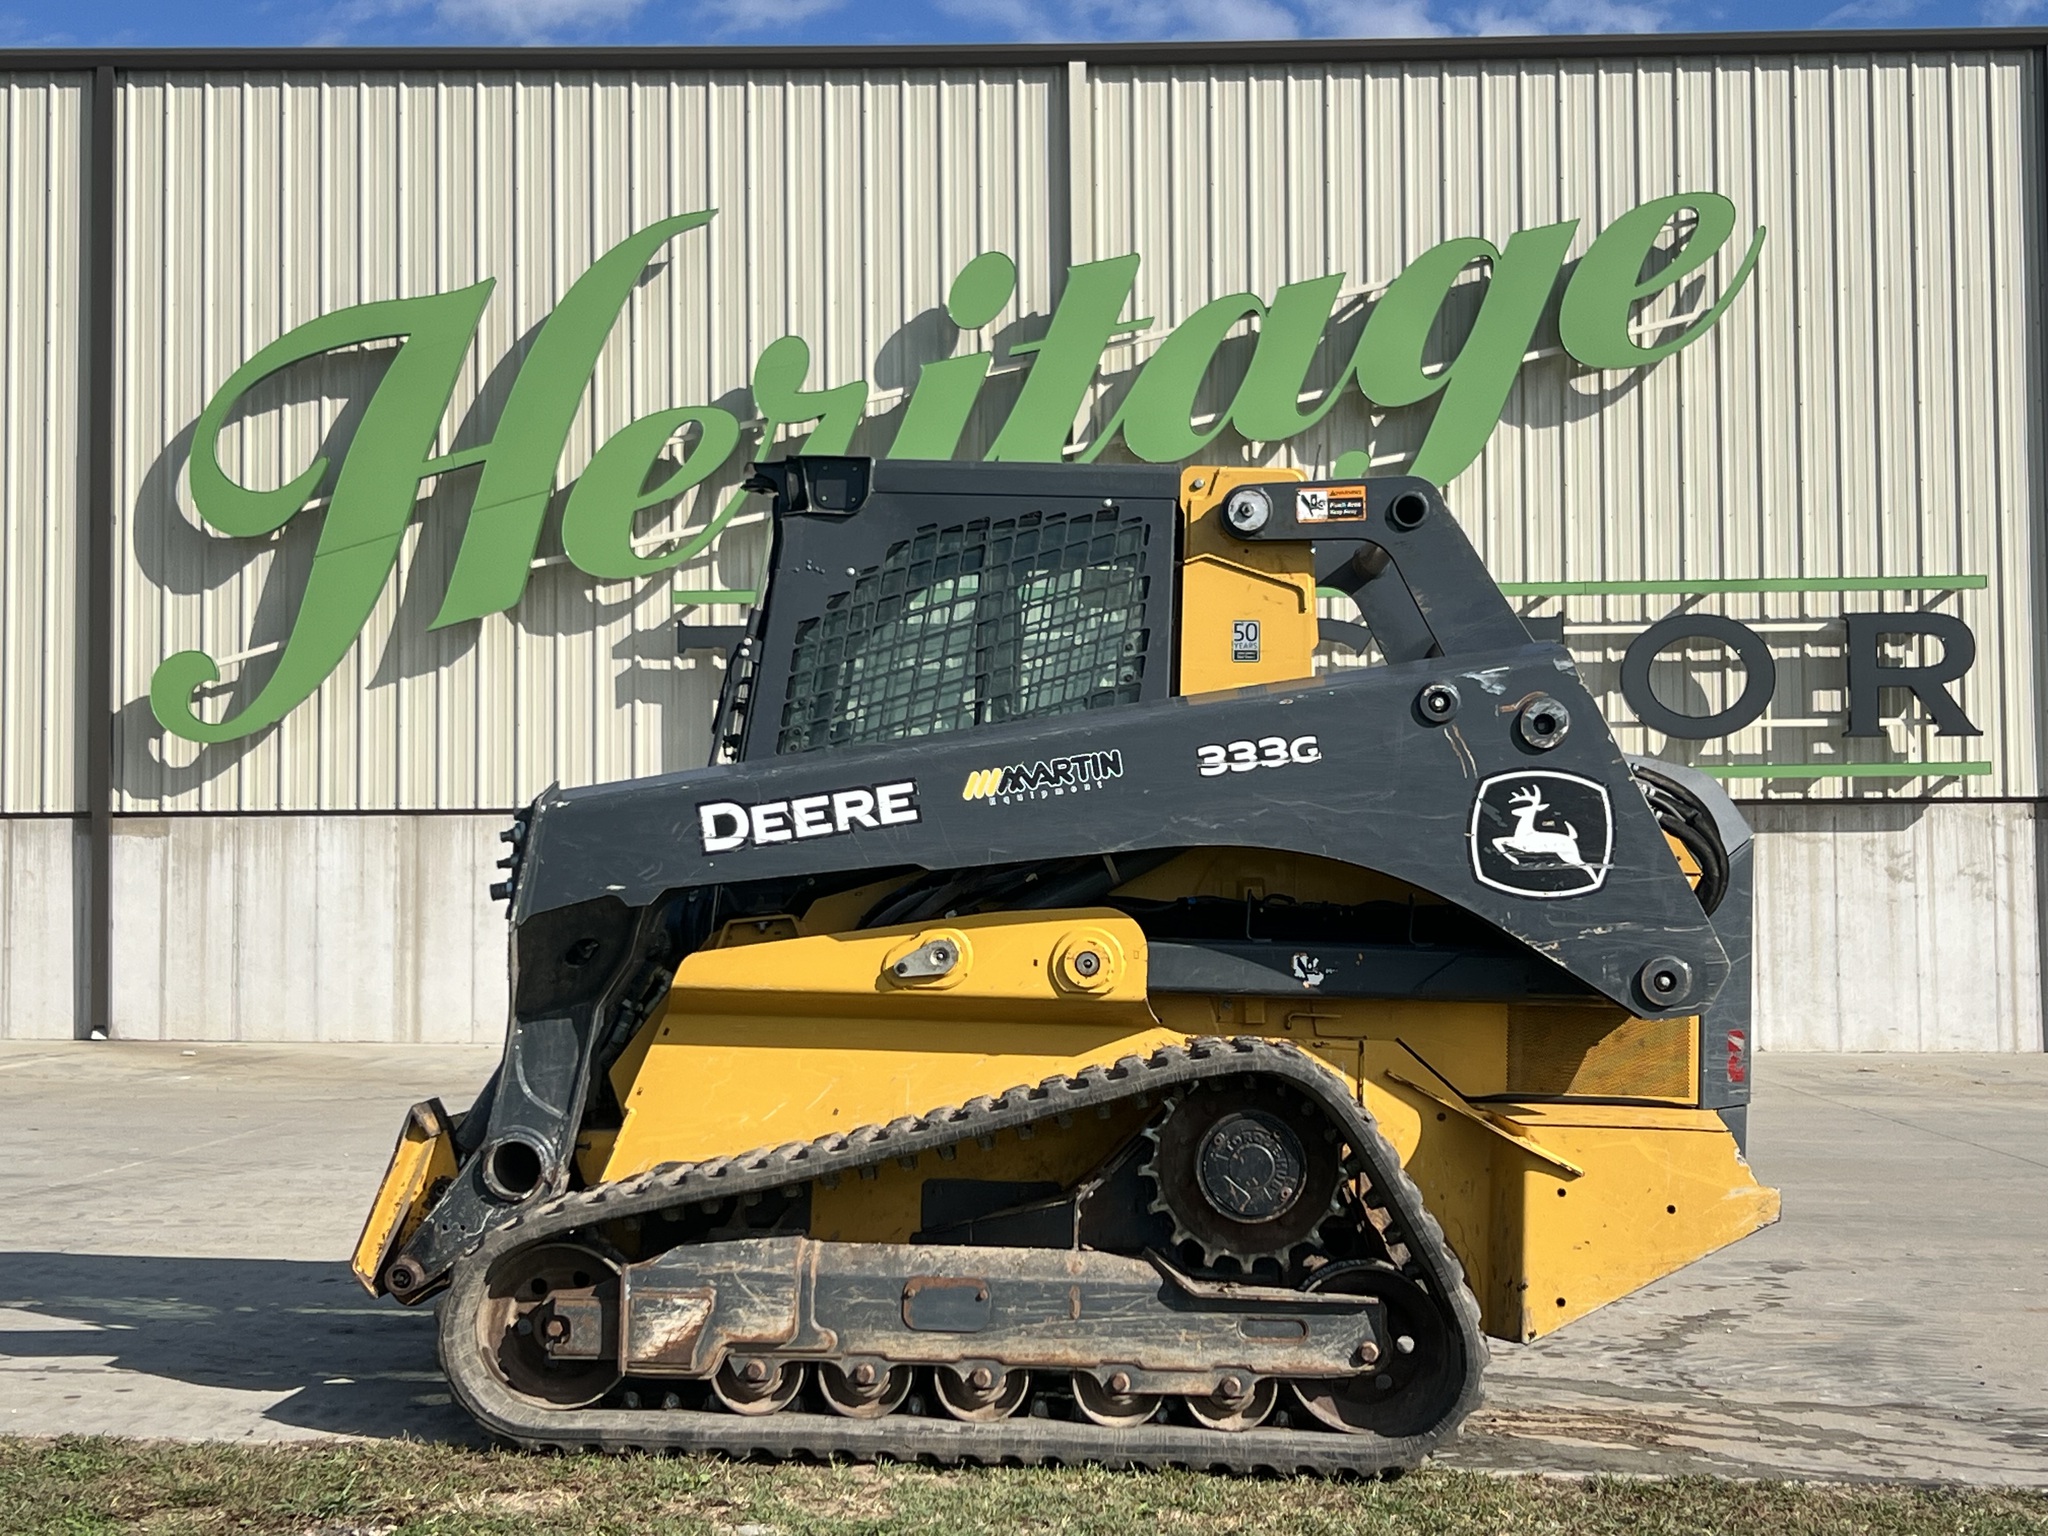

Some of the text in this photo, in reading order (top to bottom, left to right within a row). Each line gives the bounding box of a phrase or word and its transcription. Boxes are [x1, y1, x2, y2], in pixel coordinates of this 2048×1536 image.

[150, 191, 1766, 744] Heritage
[1233, 642, 1258, 650] YEARS
[1234, 622, 1258, 642] 50
[996, 749, 1124, 796] MARTIN
[1197, 735, 1322, 777] 333G
[698, 781, 919, 853] DEERE
